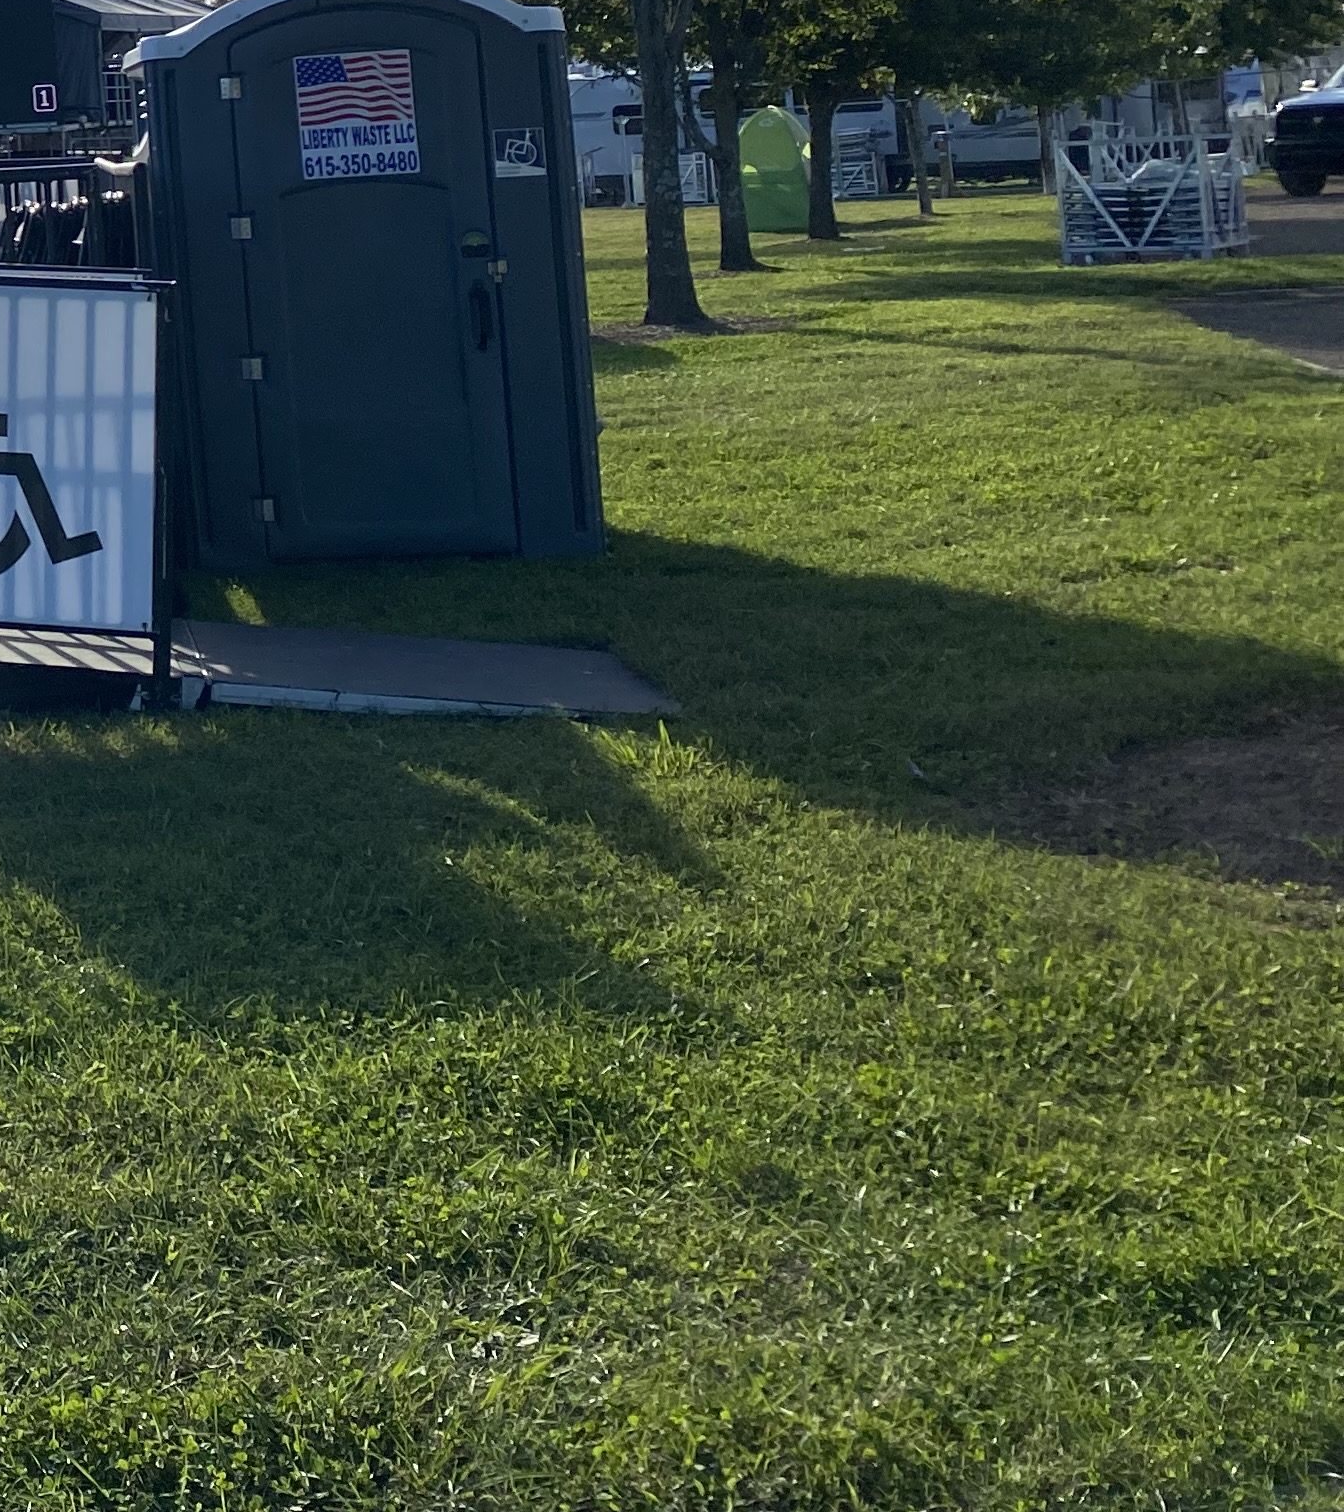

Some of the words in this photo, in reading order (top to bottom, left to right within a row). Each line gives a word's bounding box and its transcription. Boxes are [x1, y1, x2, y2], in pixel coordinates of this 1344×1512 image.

[40, 89, 50, 107] 1
[301, 127, 349, 150] LIBERTY
[352, 125, 391, 147] WASTE
[393, 123, 416, 144] LLC
[305, 150, 418, 178] 615-350-8480
